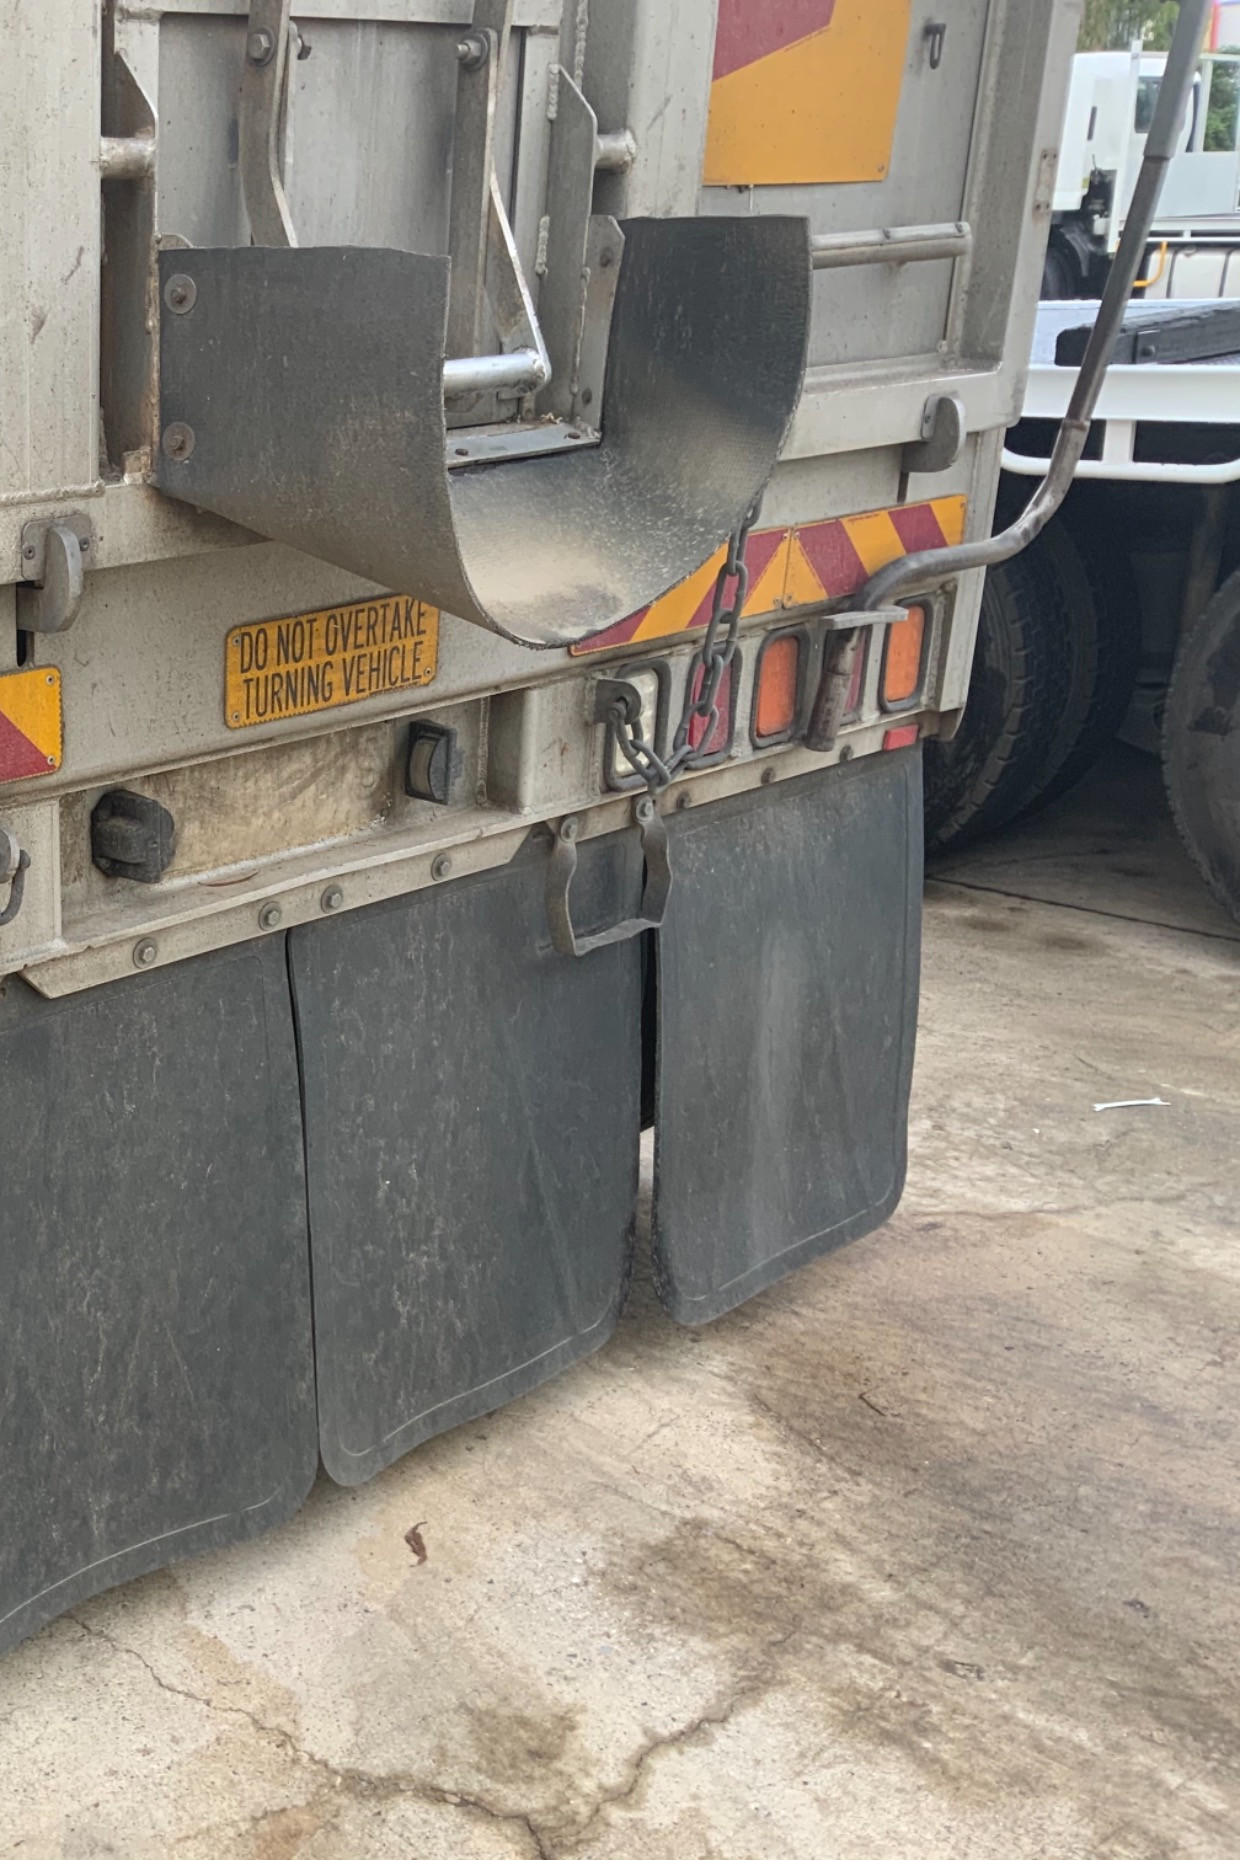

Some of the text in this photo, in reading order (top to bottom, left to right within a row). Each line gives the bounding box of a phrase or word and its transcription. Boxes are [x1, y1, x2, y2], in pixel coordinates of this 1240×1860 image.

[240, 599, 426, 674] DO NOT OVERTAKE
[243, 640, 423, 719] TURNING VEHICLE
